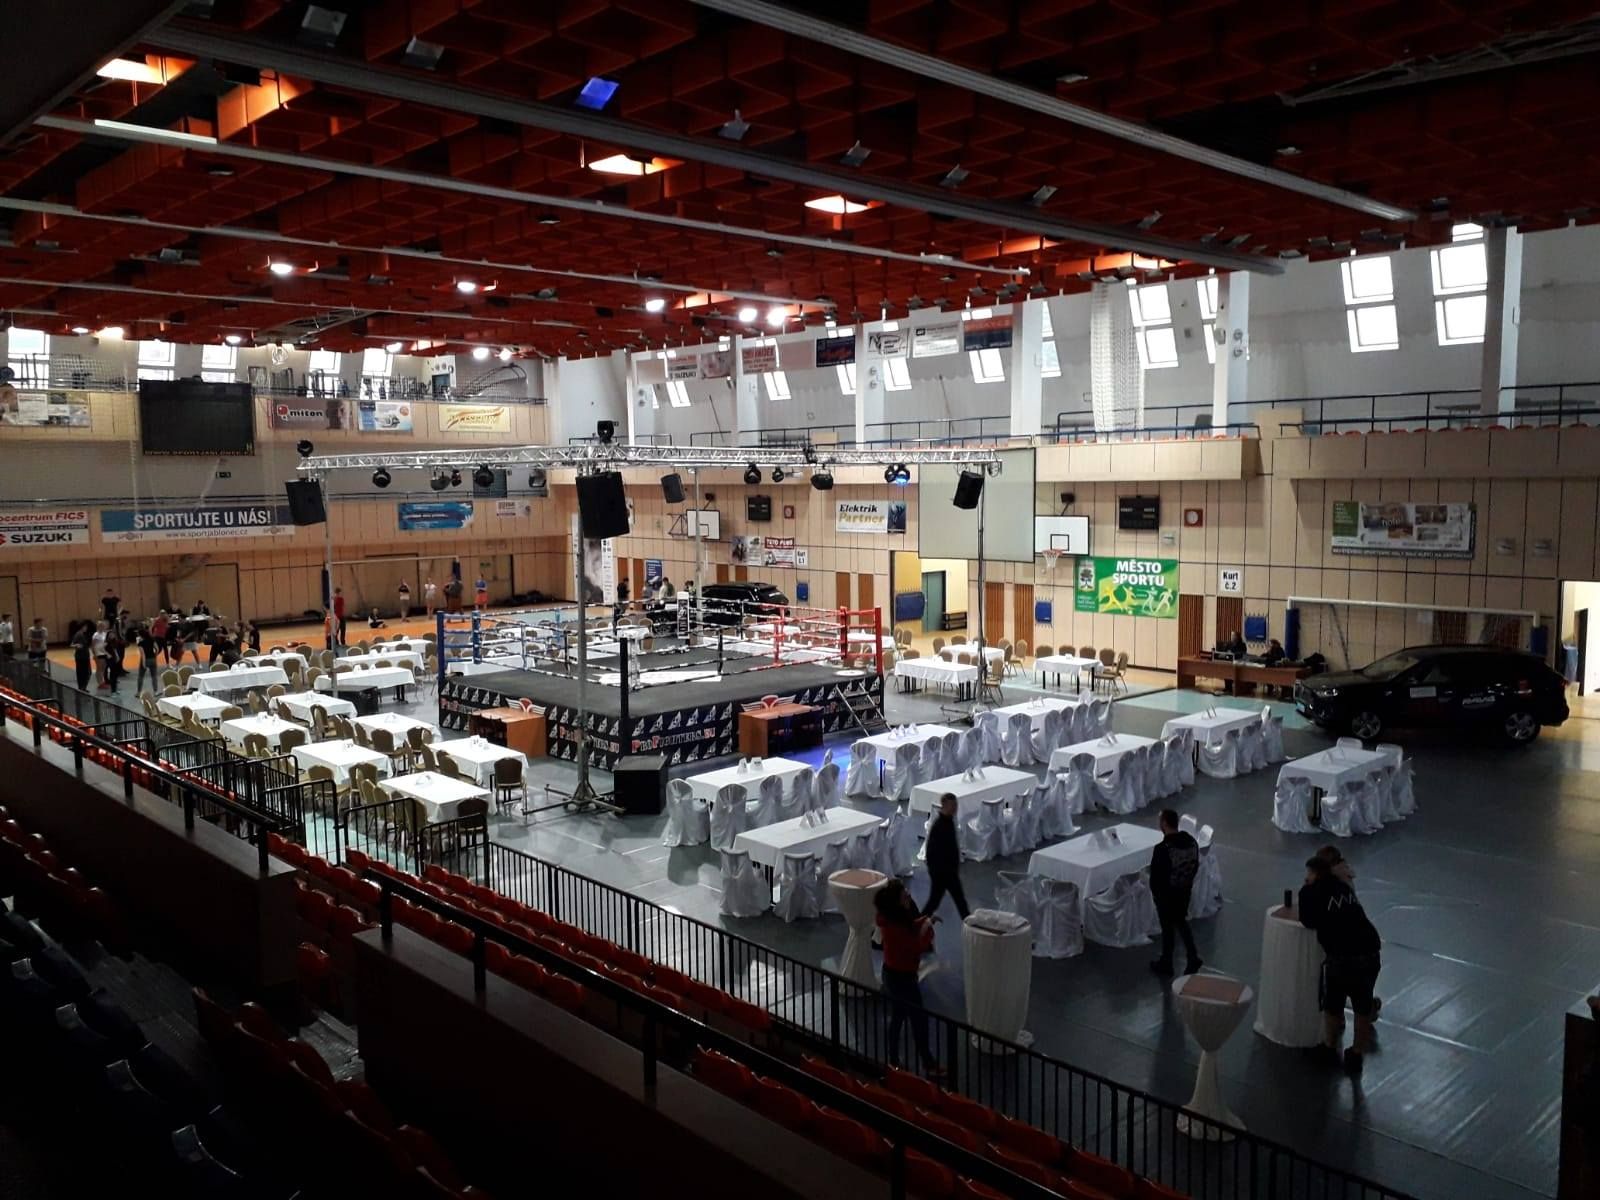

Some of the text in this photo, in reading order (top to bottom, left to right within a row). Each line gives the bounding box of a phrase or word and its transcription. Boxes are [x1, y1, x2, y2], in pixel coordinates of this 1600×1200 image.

[839, 503, 878, 513] Elektrik
[56, 511, 85, 520] FICS
[134, 508, 271, 529] SPORTUJTE U NÁS!
[838, 512, 885, 524] Partner
[11, 532, 73, 543] SUZUKI
[1116, 559, 1162, 574] MĚSTO
[1112, 573, 1165, 586] SPORTU
[1223, 571, 1238, 581] Kurt
